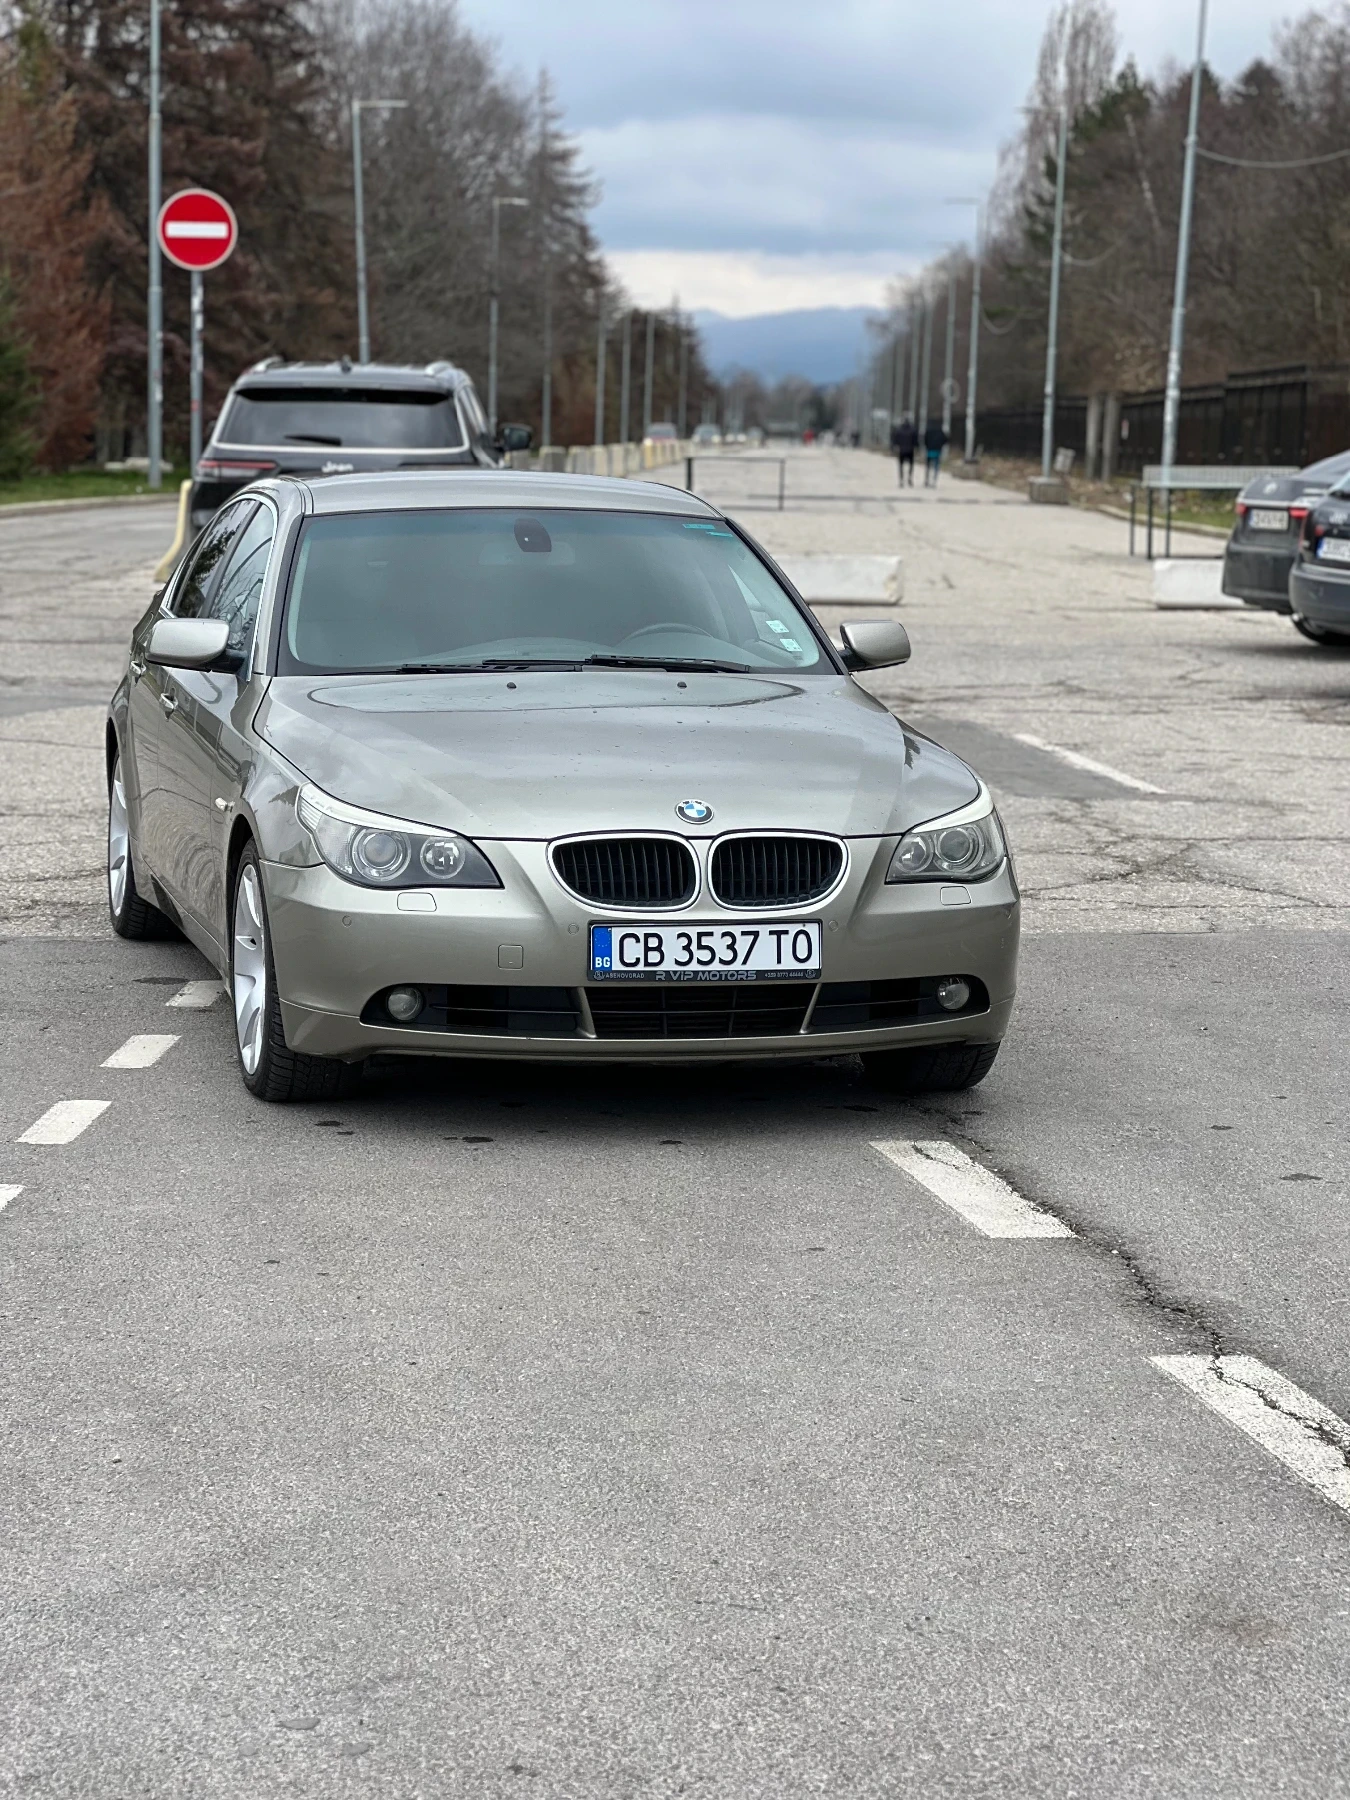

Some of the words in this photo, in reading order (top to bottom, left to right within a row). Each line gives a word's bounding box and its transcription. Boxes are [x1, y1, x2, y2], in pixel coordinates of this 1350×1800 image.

[619, 932, 665, 967] CB
[674, 930, 760, 966] 3537
[768, 928, 813, 964] TO
[595, 956, 611, 968] BG
[656, 970, 666, 981] R
[697, 970, 757, 981] MOTORS
